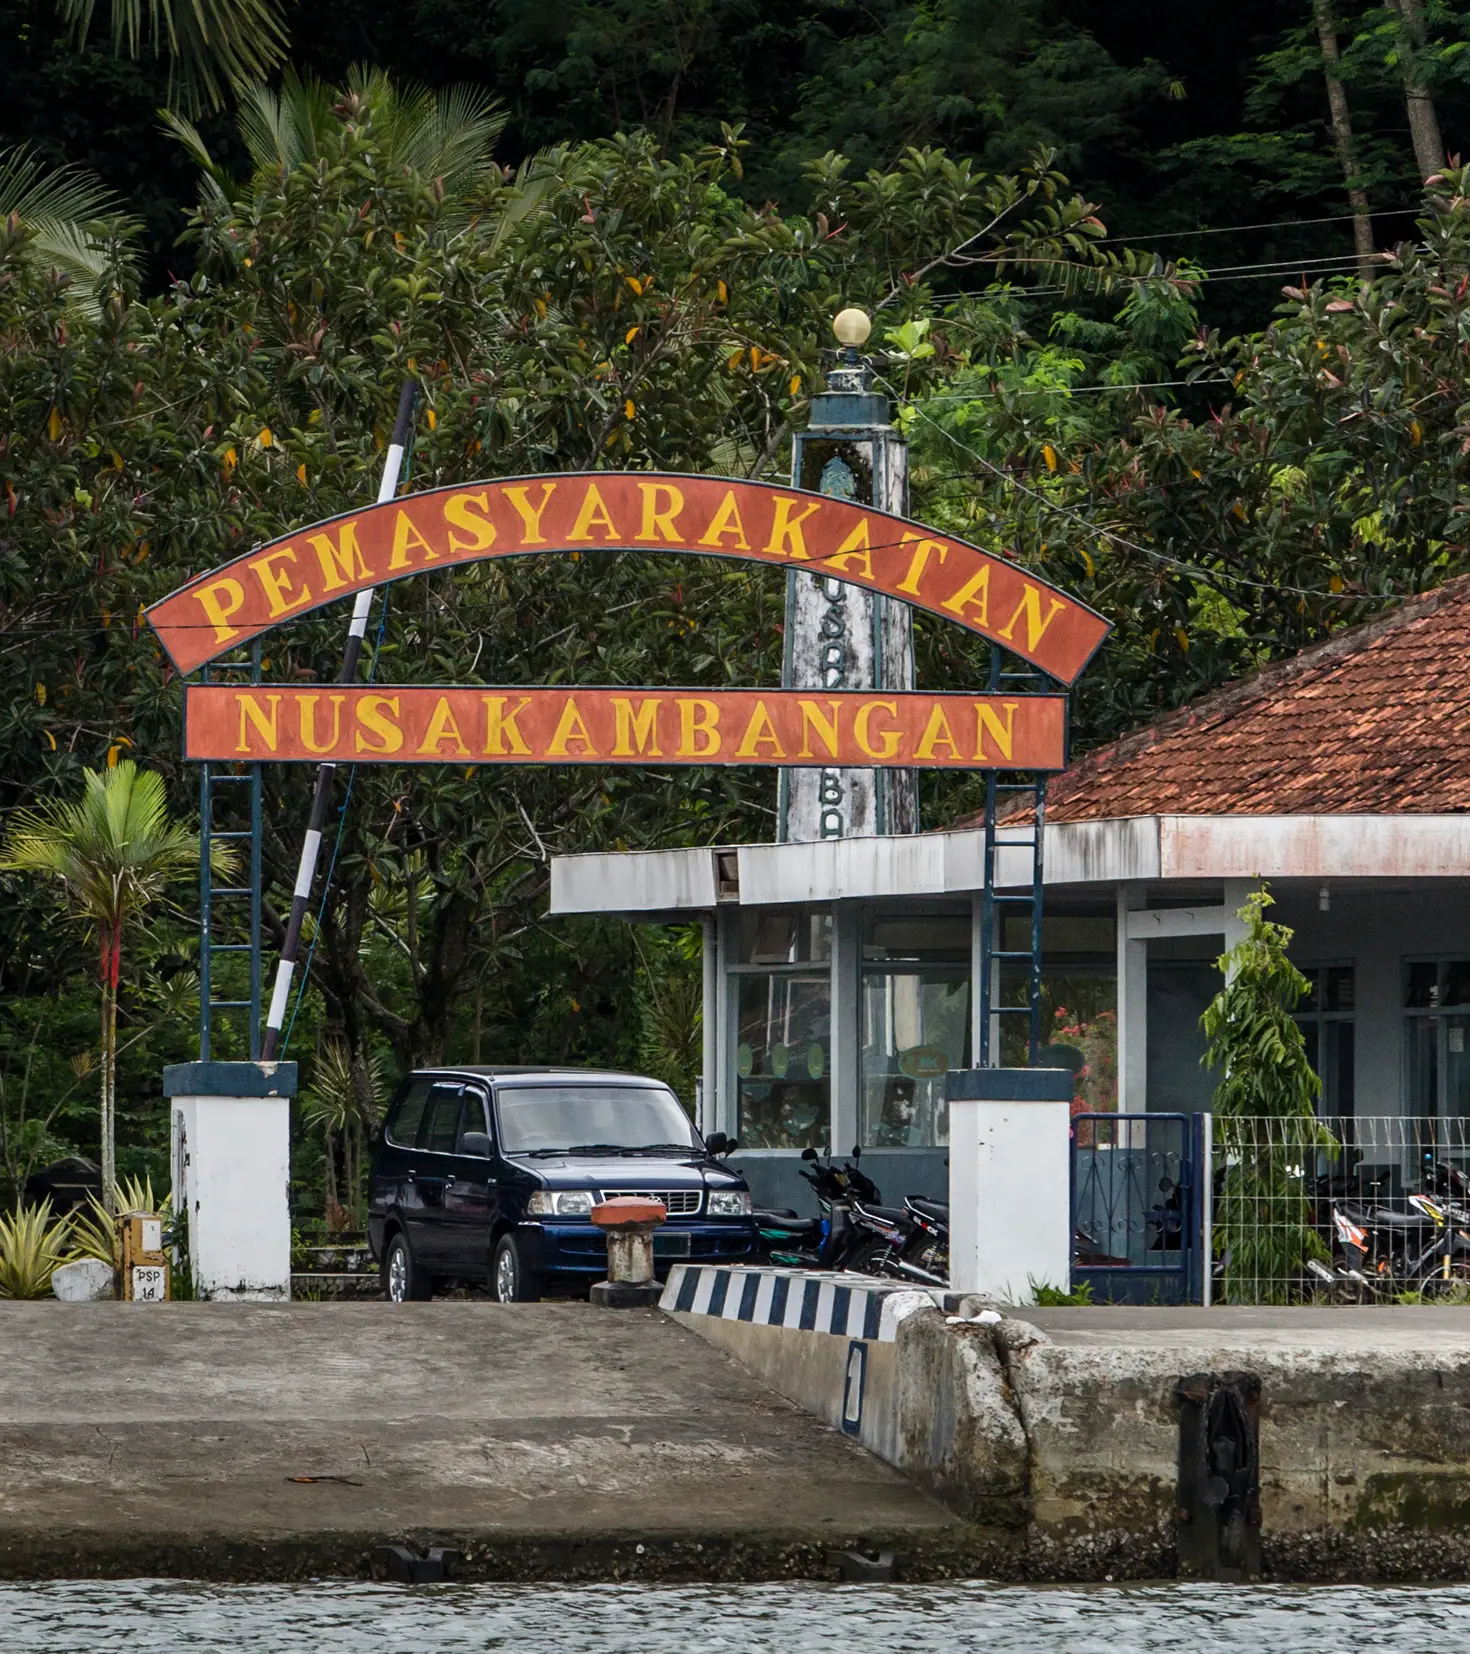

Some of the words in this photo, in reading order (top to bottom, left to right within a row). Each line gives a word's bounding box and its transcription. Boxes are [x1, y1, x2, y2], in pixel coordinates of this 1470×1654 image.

[192, 482, 1067, 652] PEMASYARAKATAN
[236, 694, 1019, 761] NUSAKAMBANGAN
[138, 1271, 161, 1282] PSP
